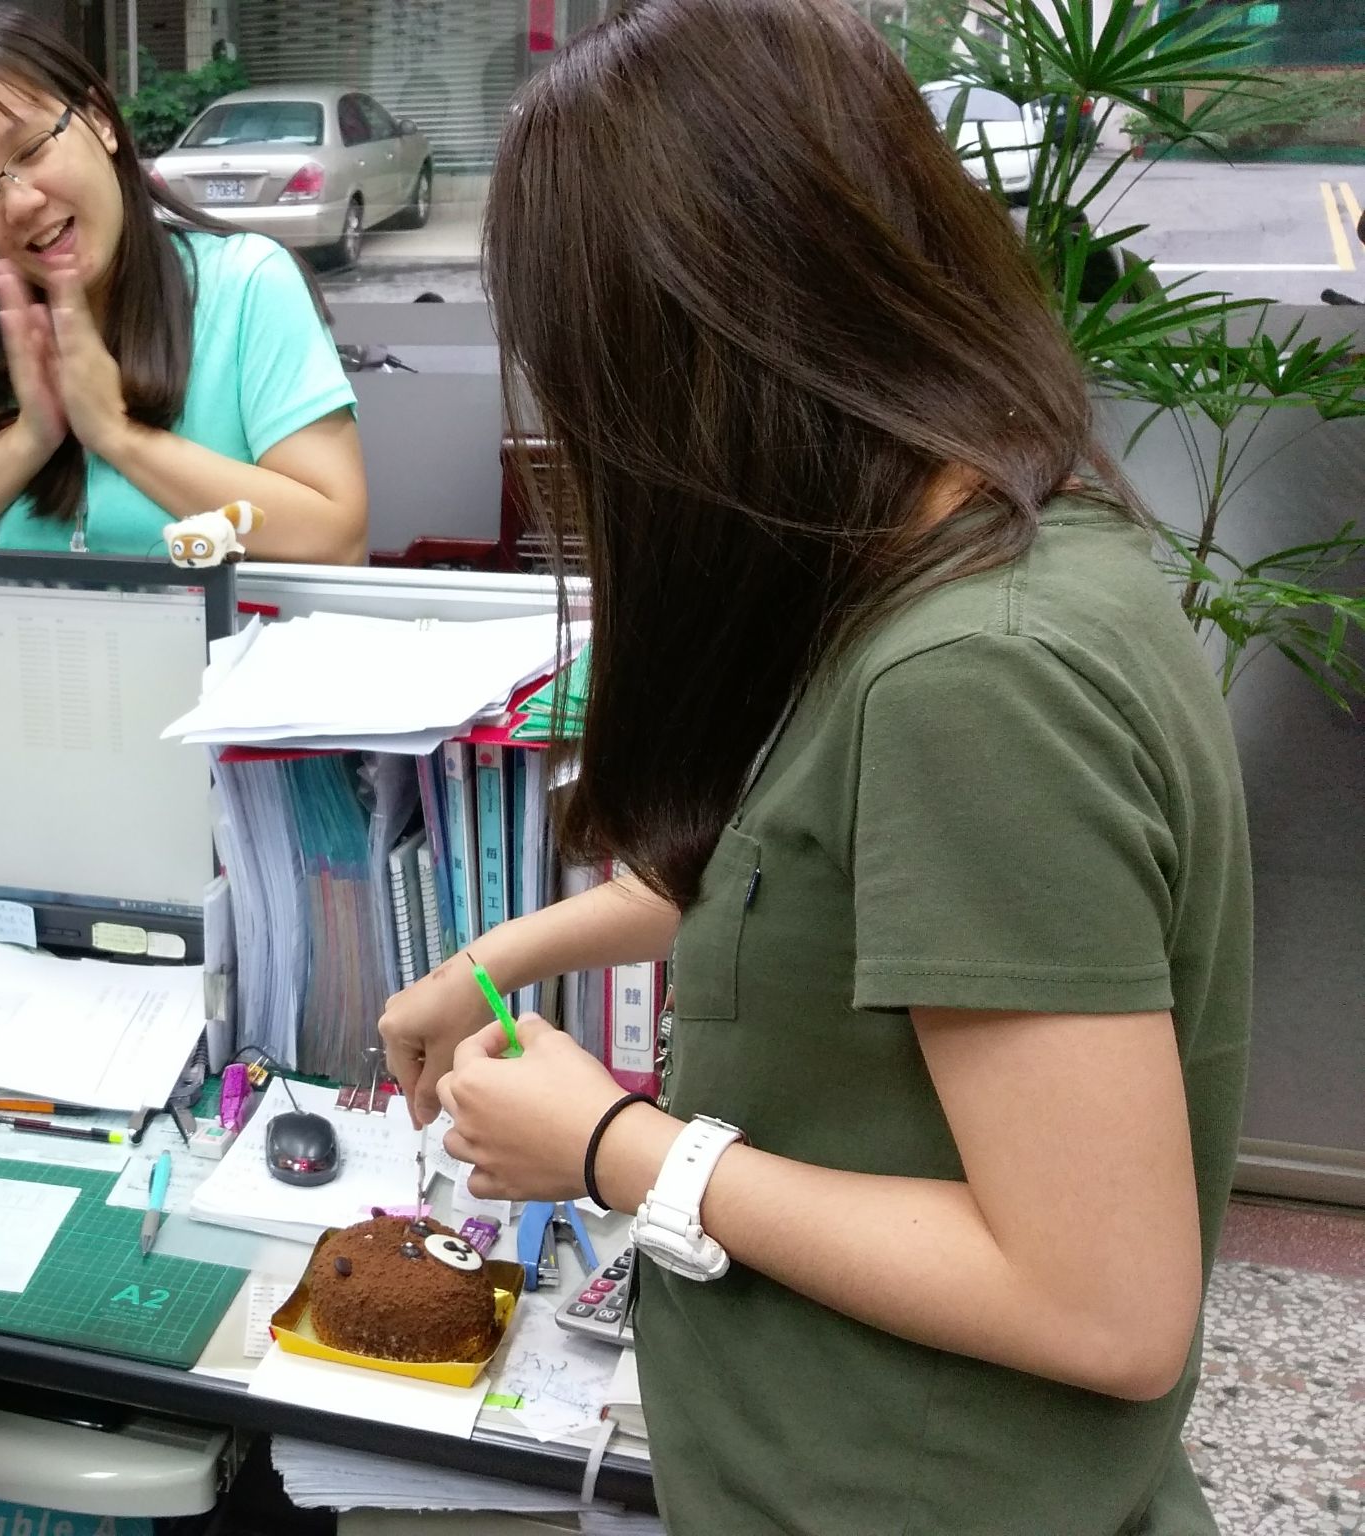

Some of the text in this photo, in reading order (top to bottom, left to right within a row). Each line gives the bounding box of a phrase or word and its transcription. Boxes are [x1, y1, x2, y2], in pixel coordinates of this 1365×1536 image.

[111, 1284, 170, 1310] A2
[582, 1292, 600, 1300] AC
[576, 1304, 586, 1312] 0
[598, 1309, 616, 1318] 00
